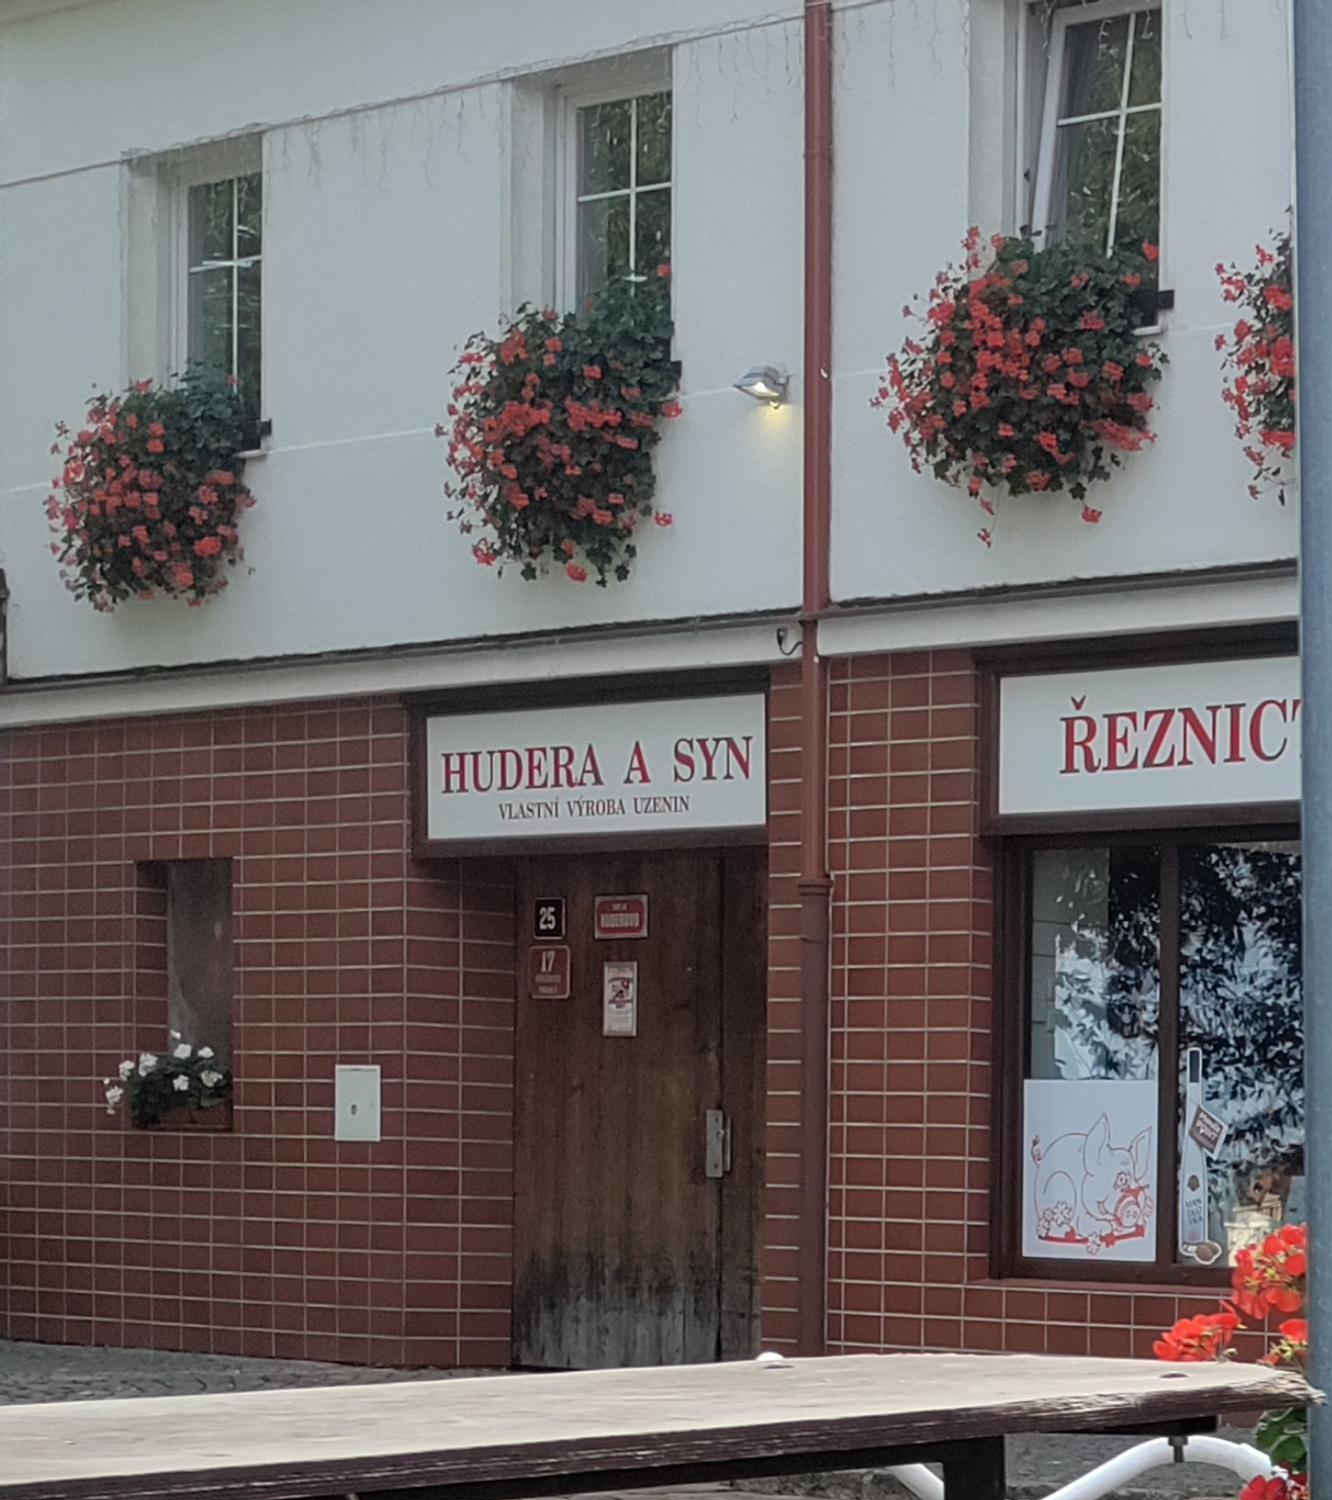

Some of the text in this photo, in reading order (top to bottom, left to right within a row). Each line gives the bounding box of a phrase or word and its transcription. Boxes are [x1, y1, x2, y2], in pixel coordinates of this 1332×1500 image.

[441, 736, 754, 794] HUDERA A SYN
[498, 795, 691, 821] VLASTNÍ VÝROBA UZENIN
[539, 906, 556, 930] 25
[541, 950, 556, 973] 17
